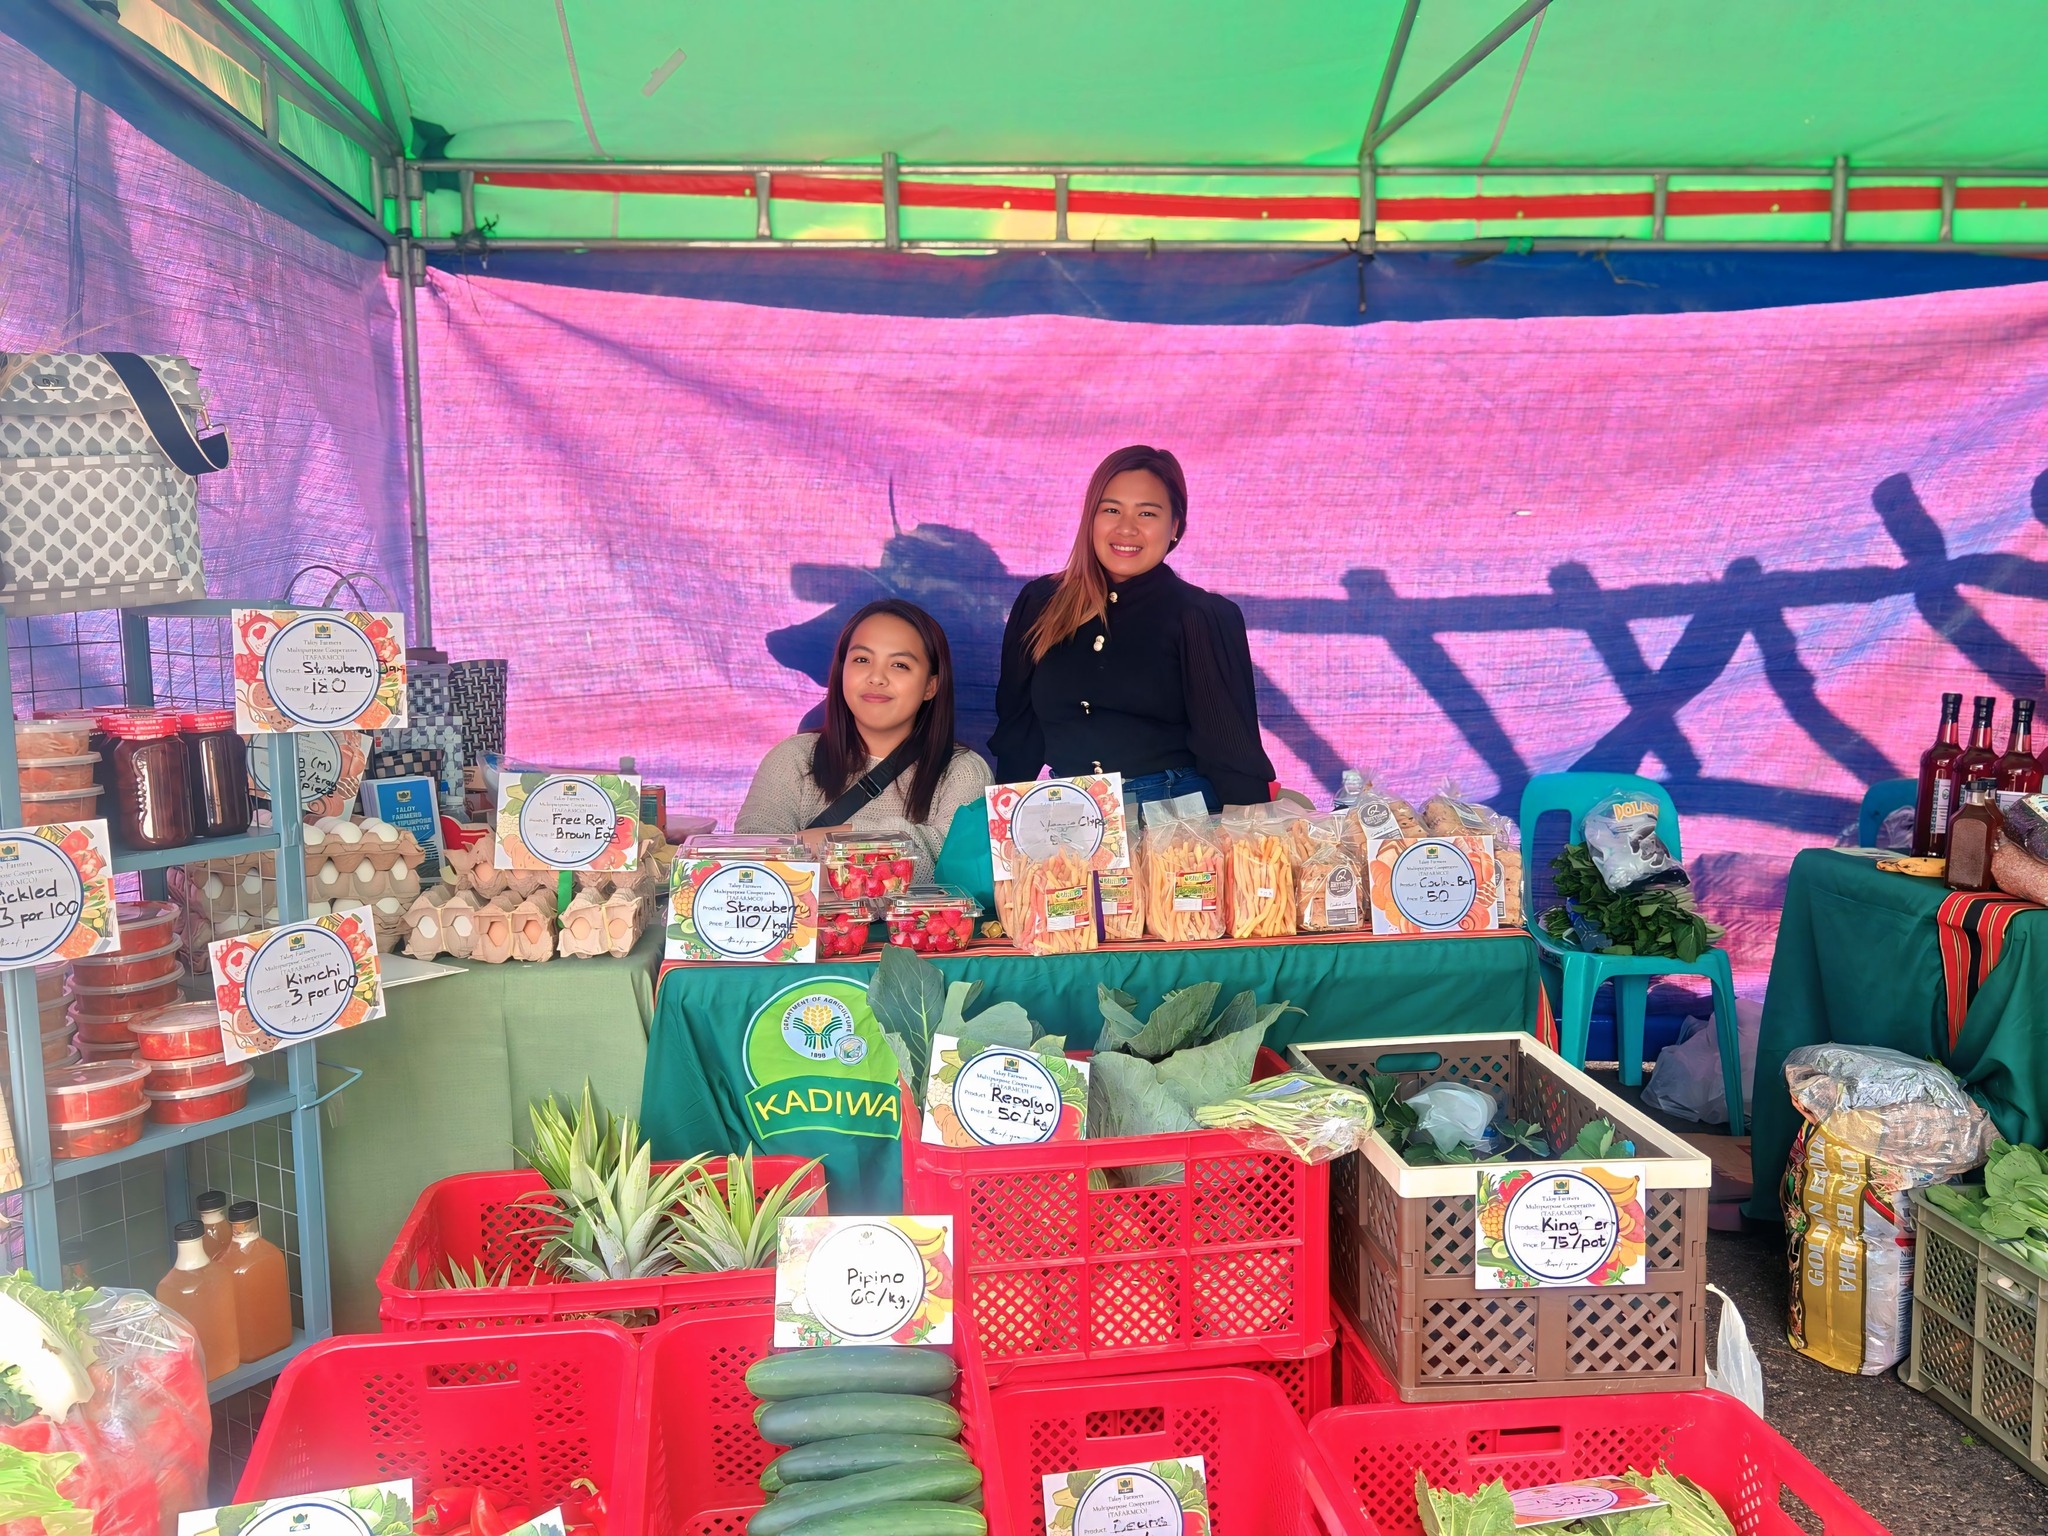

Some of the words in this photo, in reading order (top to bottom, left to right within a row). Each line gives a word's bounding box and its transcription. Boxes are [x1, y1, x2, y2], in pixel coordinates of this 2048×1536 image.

[392, 812, 422, 820] FARMERS
[552, 813, 581, 826] Free
[556, 827, 591, 839] Brown
[7, 861, 33, 869] Farmers
[14, 867, 54, 877] Cooperative
[0, 879, 57, 904] ickled
[1427, 890, 1449, 903] 50
[50, 901, 80, 919] 100
[772, 929, 794, 940] kilo
[286, 963, 340, 989] Kimchi
[289, 989, 303, 1006] 3
[334, 974, 358, 995] 100
[783, 998, 809, 1031] DEPARTMENT
[824, 997, 852, 1033] AGRICULTURE
[755, 1088, 898, 1122] KADIWA
[991, 1087, 1054, 1115] Repolyo
[1542, 1217, 1578, 1236] King
[1808, 1199, 1831, 1287] GOLDEN
[847, 1267, 905, 1288] Pipino
